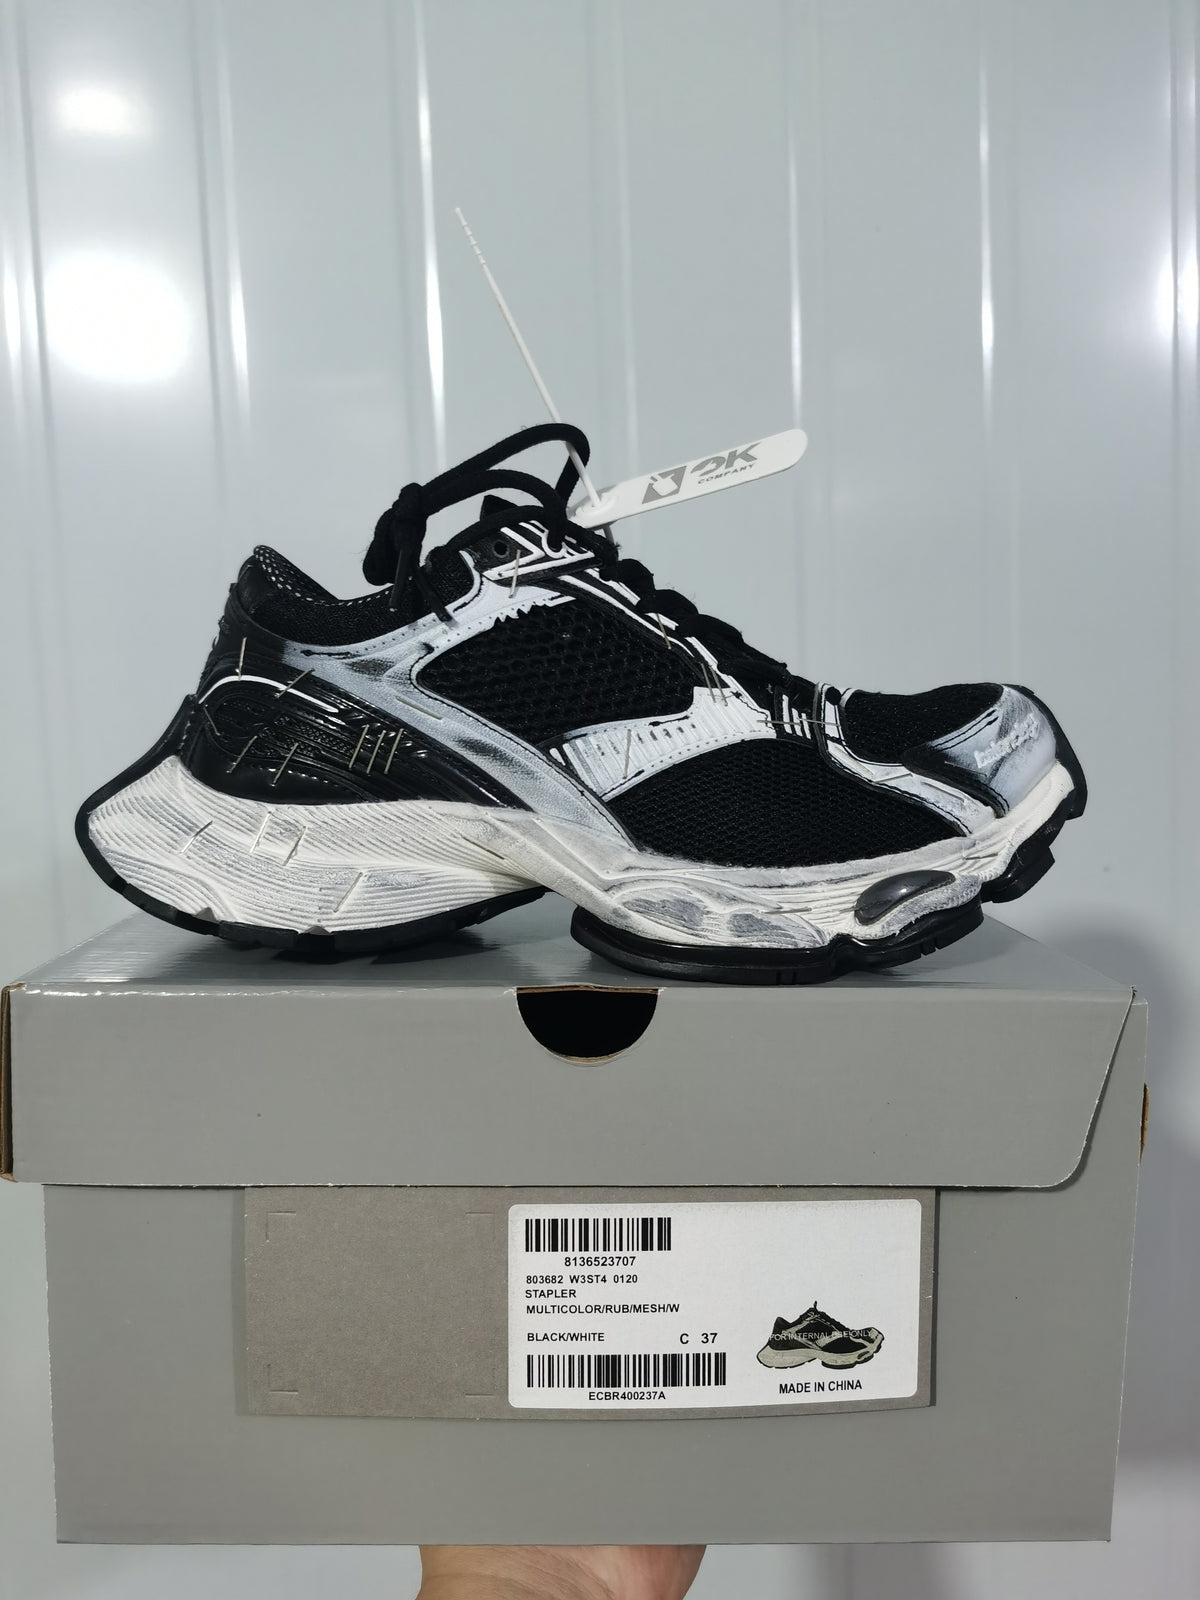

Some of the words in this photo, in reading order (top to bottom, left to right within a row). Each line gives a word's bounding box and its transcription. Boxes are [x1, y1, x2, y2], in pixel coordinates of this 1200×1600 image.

[697, 463, 755, 484] COMPANY
[564, 1255, 637, 1267] 8136523707
[526, 1274, 564, 1285] 803682
[569, 1274, 608, 1284] W3ST4
[613, 1274, 638, 1284] 0120
[525, 1288, 577, 1299] STAPLER
[526, 1303, 680, 1315] MULTICOLOR/RUB/MESH/W
[527, 1332, 605, 1342] BLACK/WHITE
[679, 1332, 689, 1345] C
[700, 1332, 718, 1344] 37
[788, 1331, 829, 1341] INTERNAL
[779, 1382, 811, 1395] MADE
[814, 1381, 825, 1393] IN
[827, 1379, 863, 1392] CHINA
[588, 1390, 666, 1401] ECBR400237A
